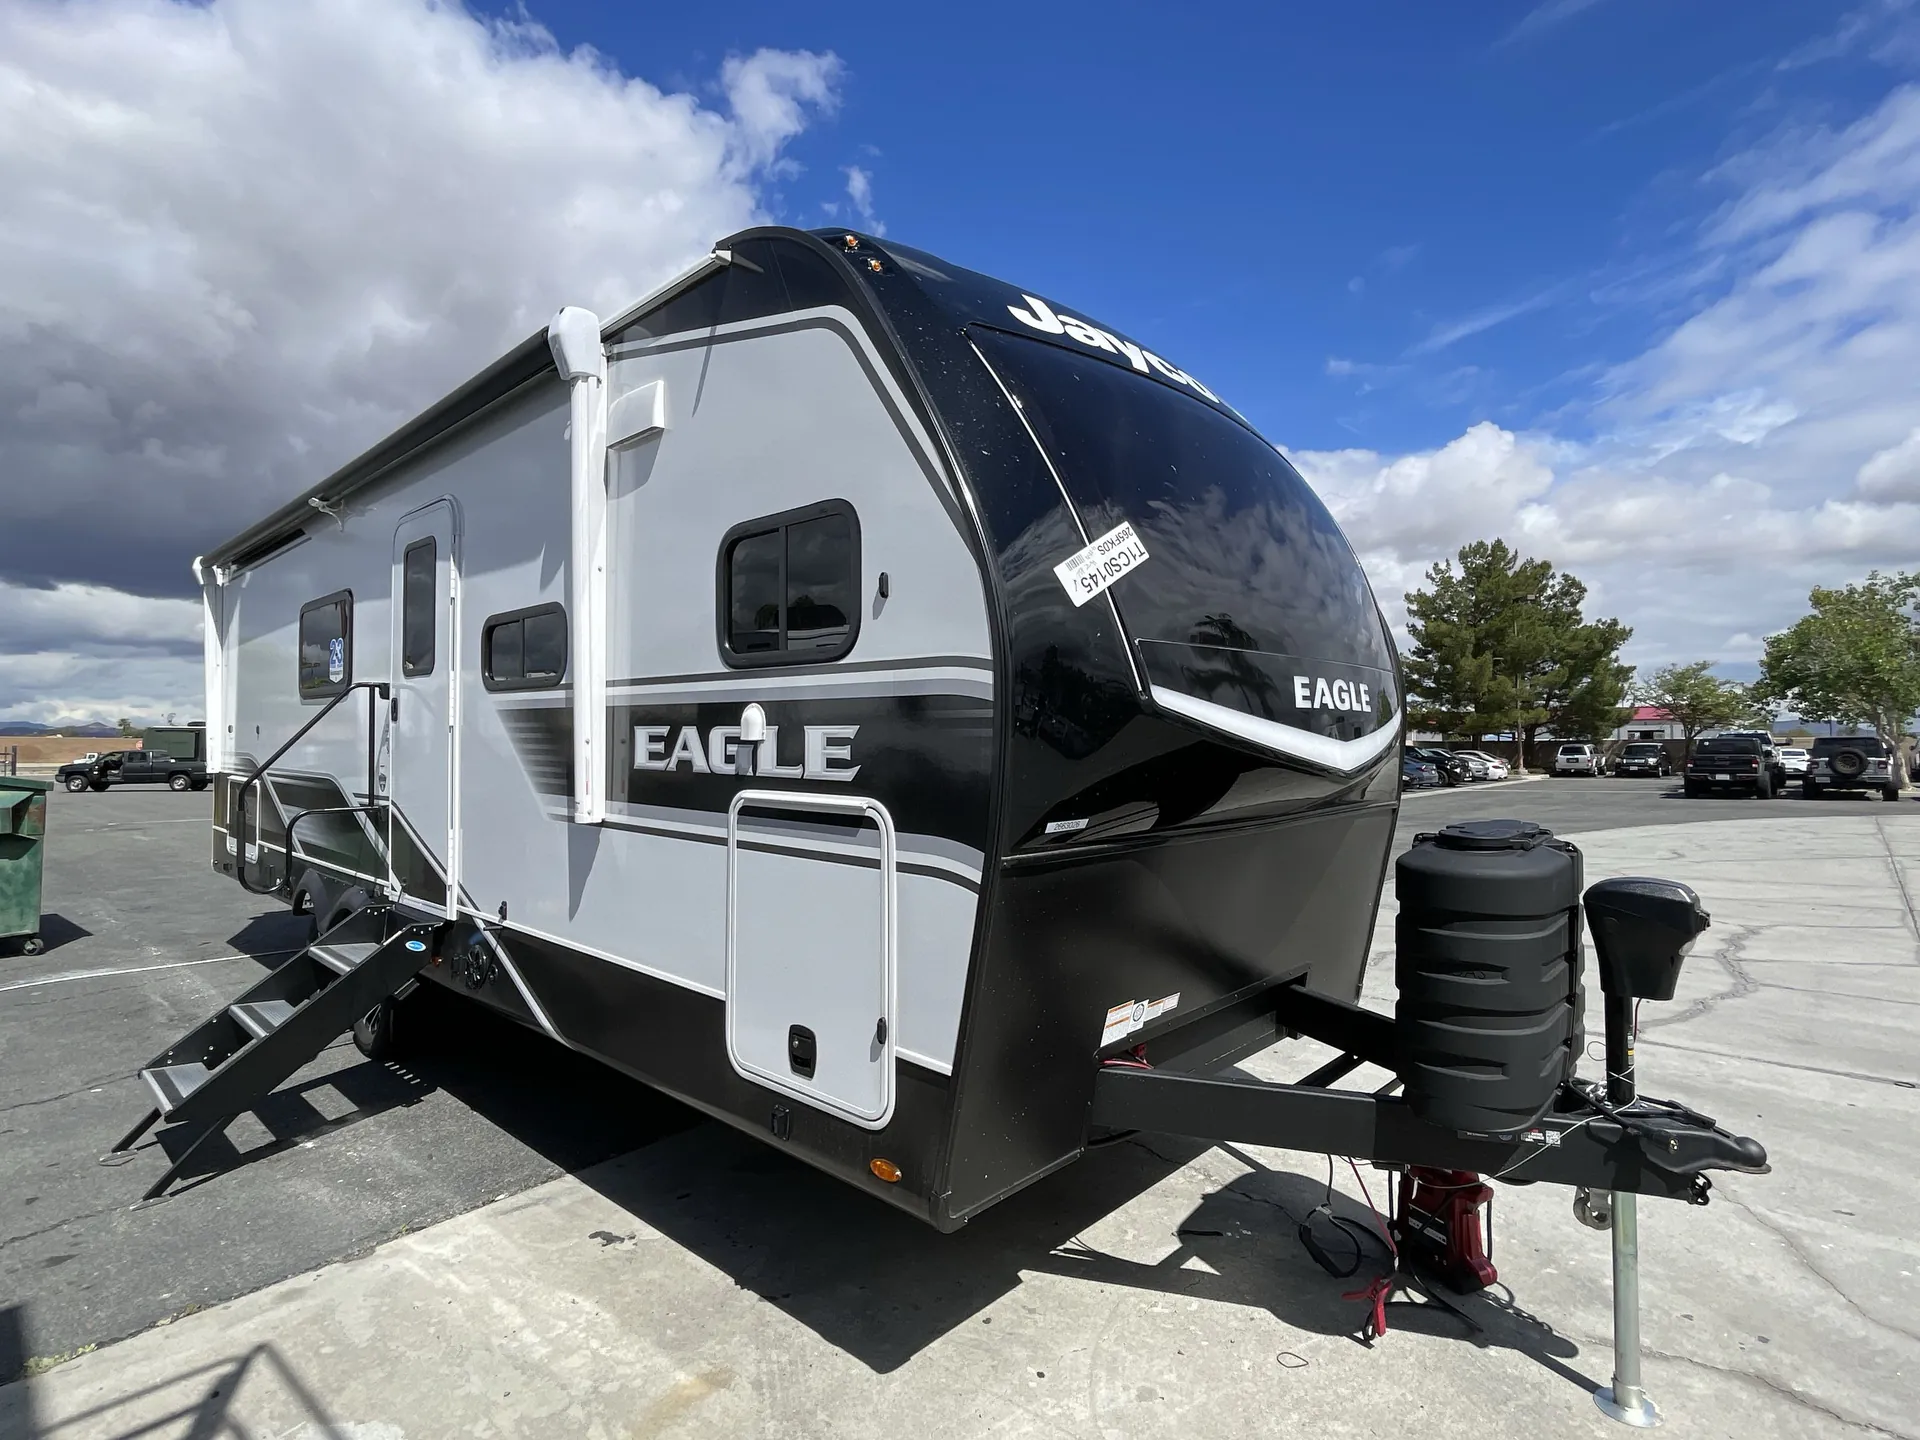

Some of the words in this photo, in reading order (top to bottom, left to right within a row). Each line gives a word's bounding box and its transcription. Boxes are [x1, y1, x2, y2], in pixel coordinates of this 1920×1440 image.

[1007, 294, 1220, 403] Jayco
[1097, 526, 1134, 556] 265FKDS
[1080, 541, 1146, 594] T1CS0145
[330, 639, 344, 665] 23
[1293, 675, 1372, 713] EAGLE
[633, 725, 862, 782] EAGLE
